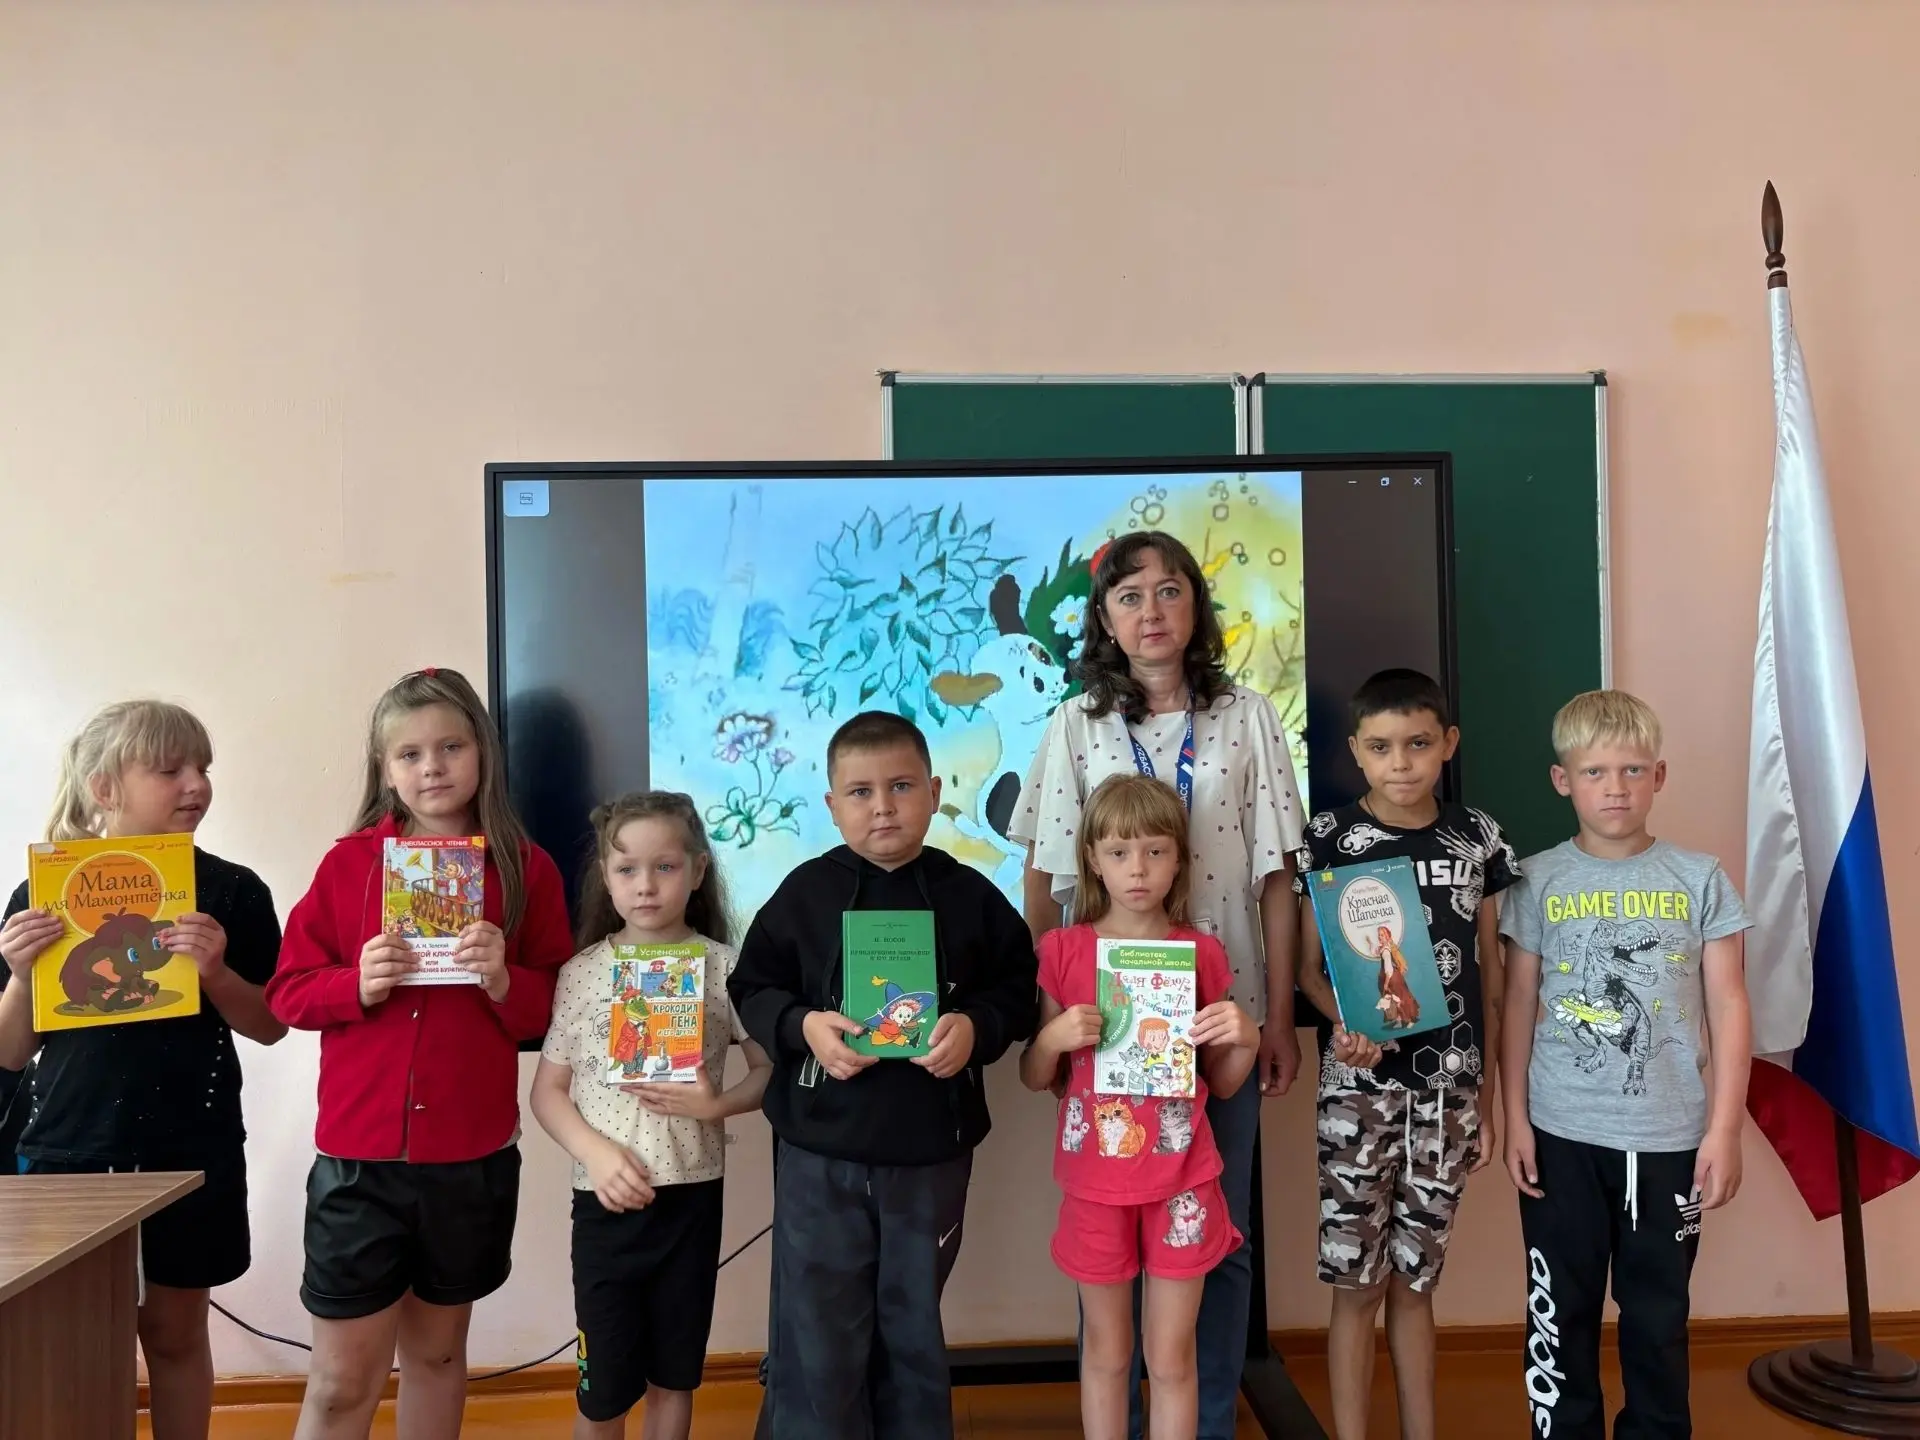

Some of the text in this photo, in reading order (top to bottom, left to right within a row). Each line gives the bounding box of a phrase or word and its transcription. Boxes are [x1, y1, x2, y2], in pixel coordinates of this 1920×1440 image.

[1411, 860, 1472, 886] ISU
[79, 870, 155, 893] Мама
[42, 887, 188, 914] для Мамонтёнка
[1346, 893, 1390, 909] Красная
[1546, 890, 1690, 923] GAME OVER
[1347, 906, 1395, 923] Шапочка
[640, 947, 691, 956] Успенский
[1120, 949, 1167, 958] Библиотека
[1120, 958, 1192, 967] начальной школы
[653, 1003, 698, 1014] КРОКОДИЛ
[671, 1015, 697, 1028] ГЕНА
